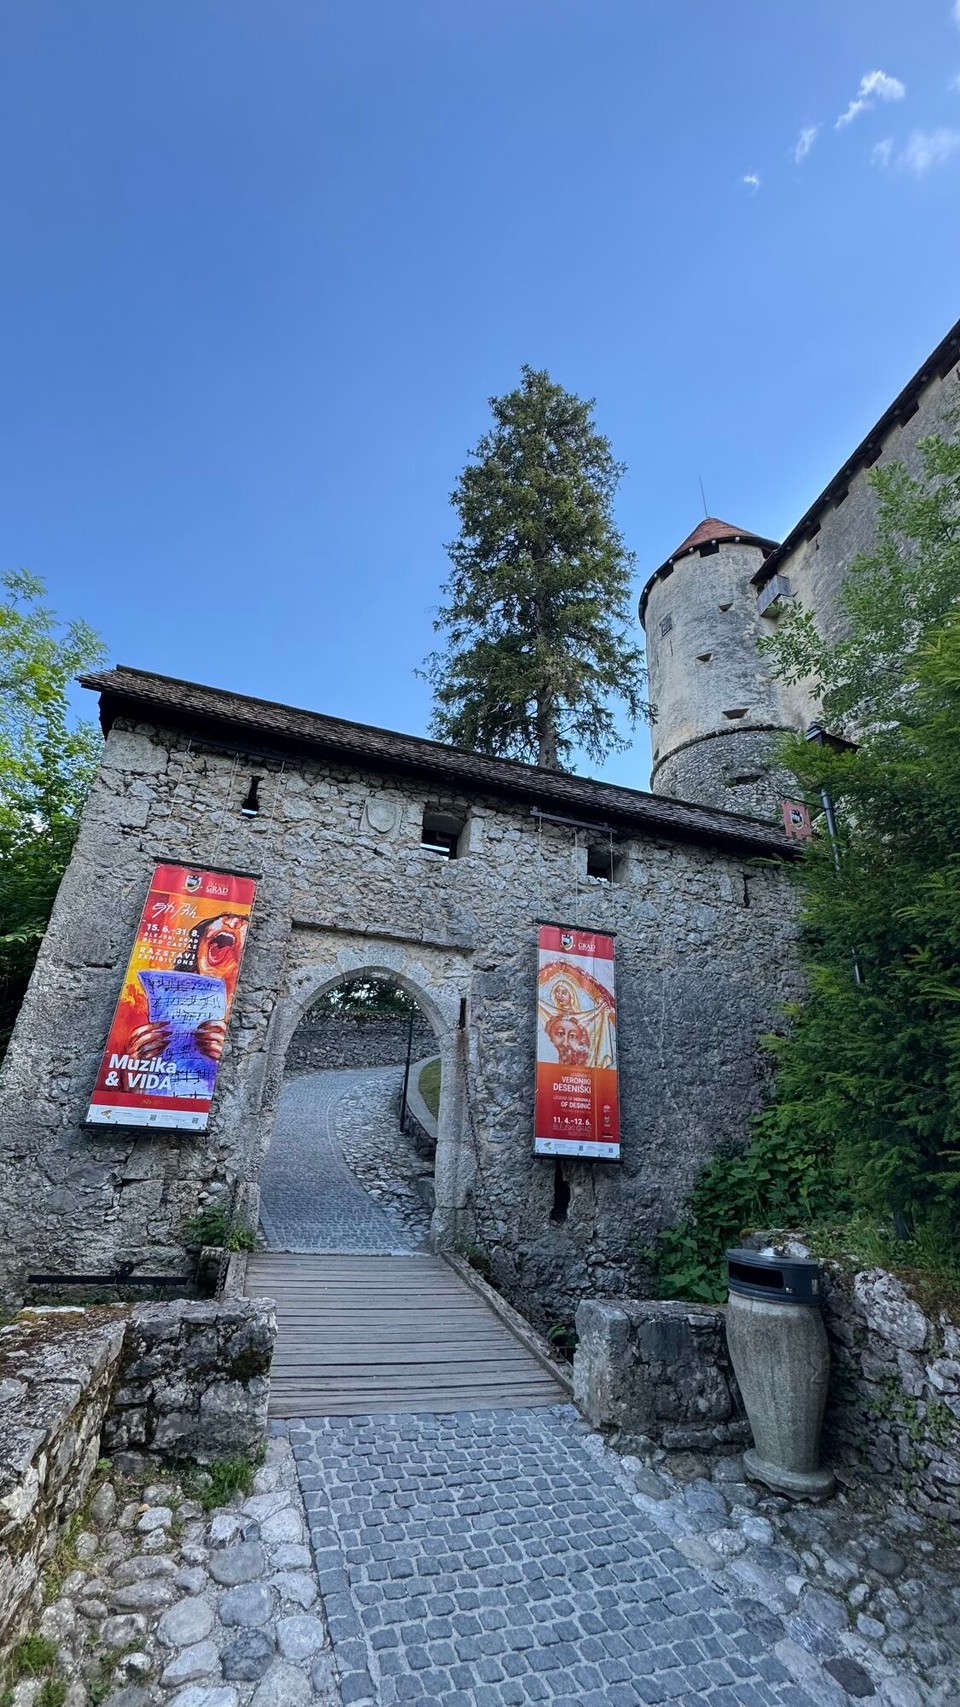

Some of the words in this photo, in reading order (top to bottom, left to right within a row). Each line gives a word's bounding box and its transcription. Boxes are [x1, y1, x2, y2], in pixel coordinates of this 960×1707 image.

[206, 885, 229, 894] GRAD
[146, 923, 160, 932] 15.
[191, 929, 200, 938] 8.
[142, 937, 163, 945] BLED
[166, 940, 198, 950] CASTLE
[144, 932, 176, 941] BLEJSKI
[179, 935, 199, 944] GRAD
[578, 942, 596, 950] GRAD
[139, 946, 196, 960] RAZSTAVI
[138, 954, 194, 966] EXHIBITIONS
[108, 1053, 178, 1074] Muzika
[105, 1071, 120, 1087] &
[127, 1072, 172, 1091] VIDA
[561, 1076, 592, 1086] VERONIKI
[553, 1082, 592, 1094] DESENIŠKI
[553, 1116, 564, 1124] 11.
[585, 1118, 592, 1126] 6.
